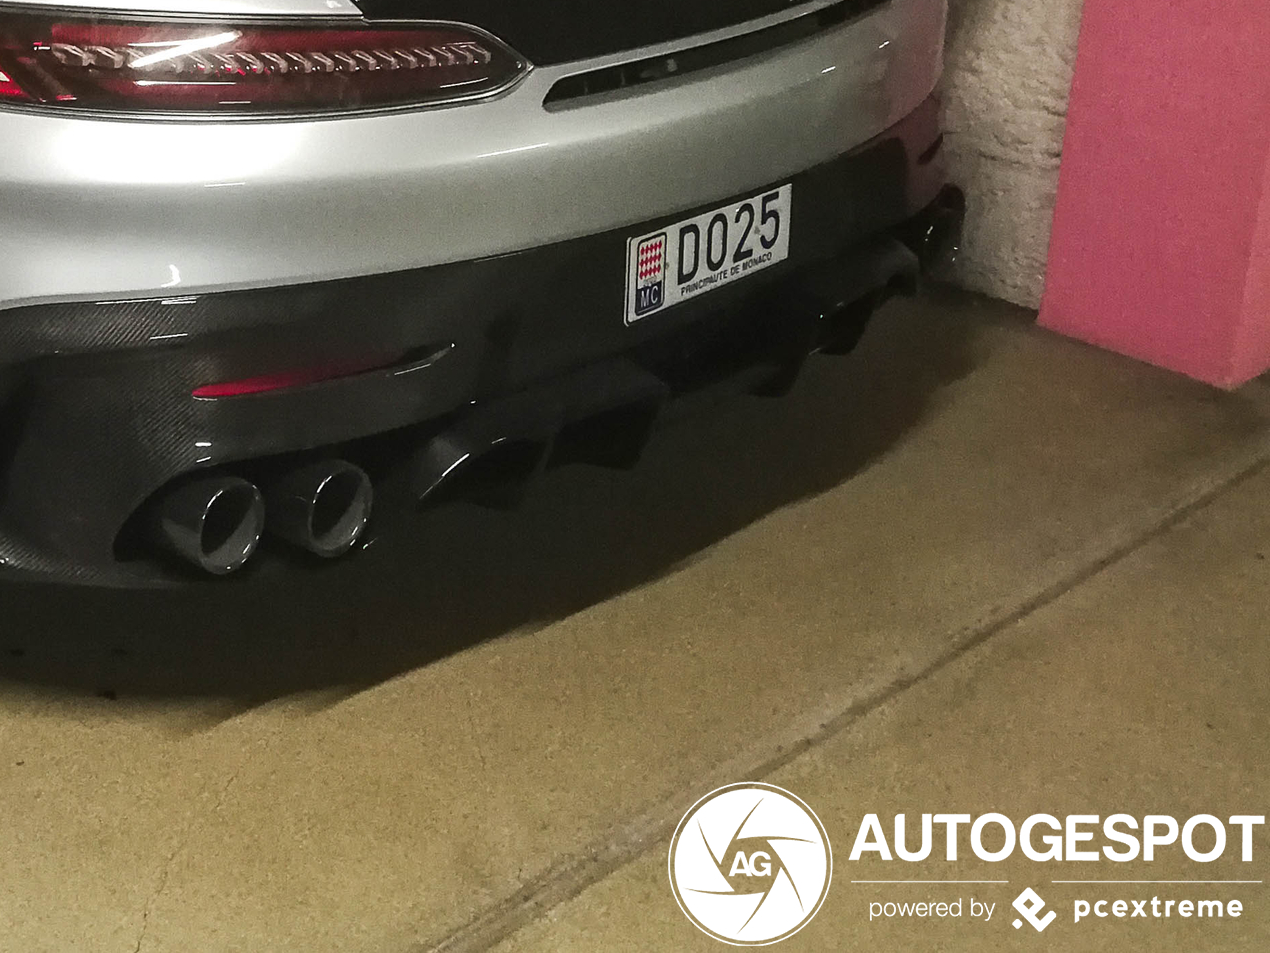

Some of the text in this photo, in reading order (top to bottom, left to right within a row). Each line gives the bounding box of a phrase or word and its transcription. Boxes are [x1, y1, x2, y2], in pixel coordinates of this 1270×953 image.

[677, 190, 780, 286] D025
[730, 264, 740, 276] DE
[742, 251, 773, 271] MONACO
[640, 285, 659, 308] MC
